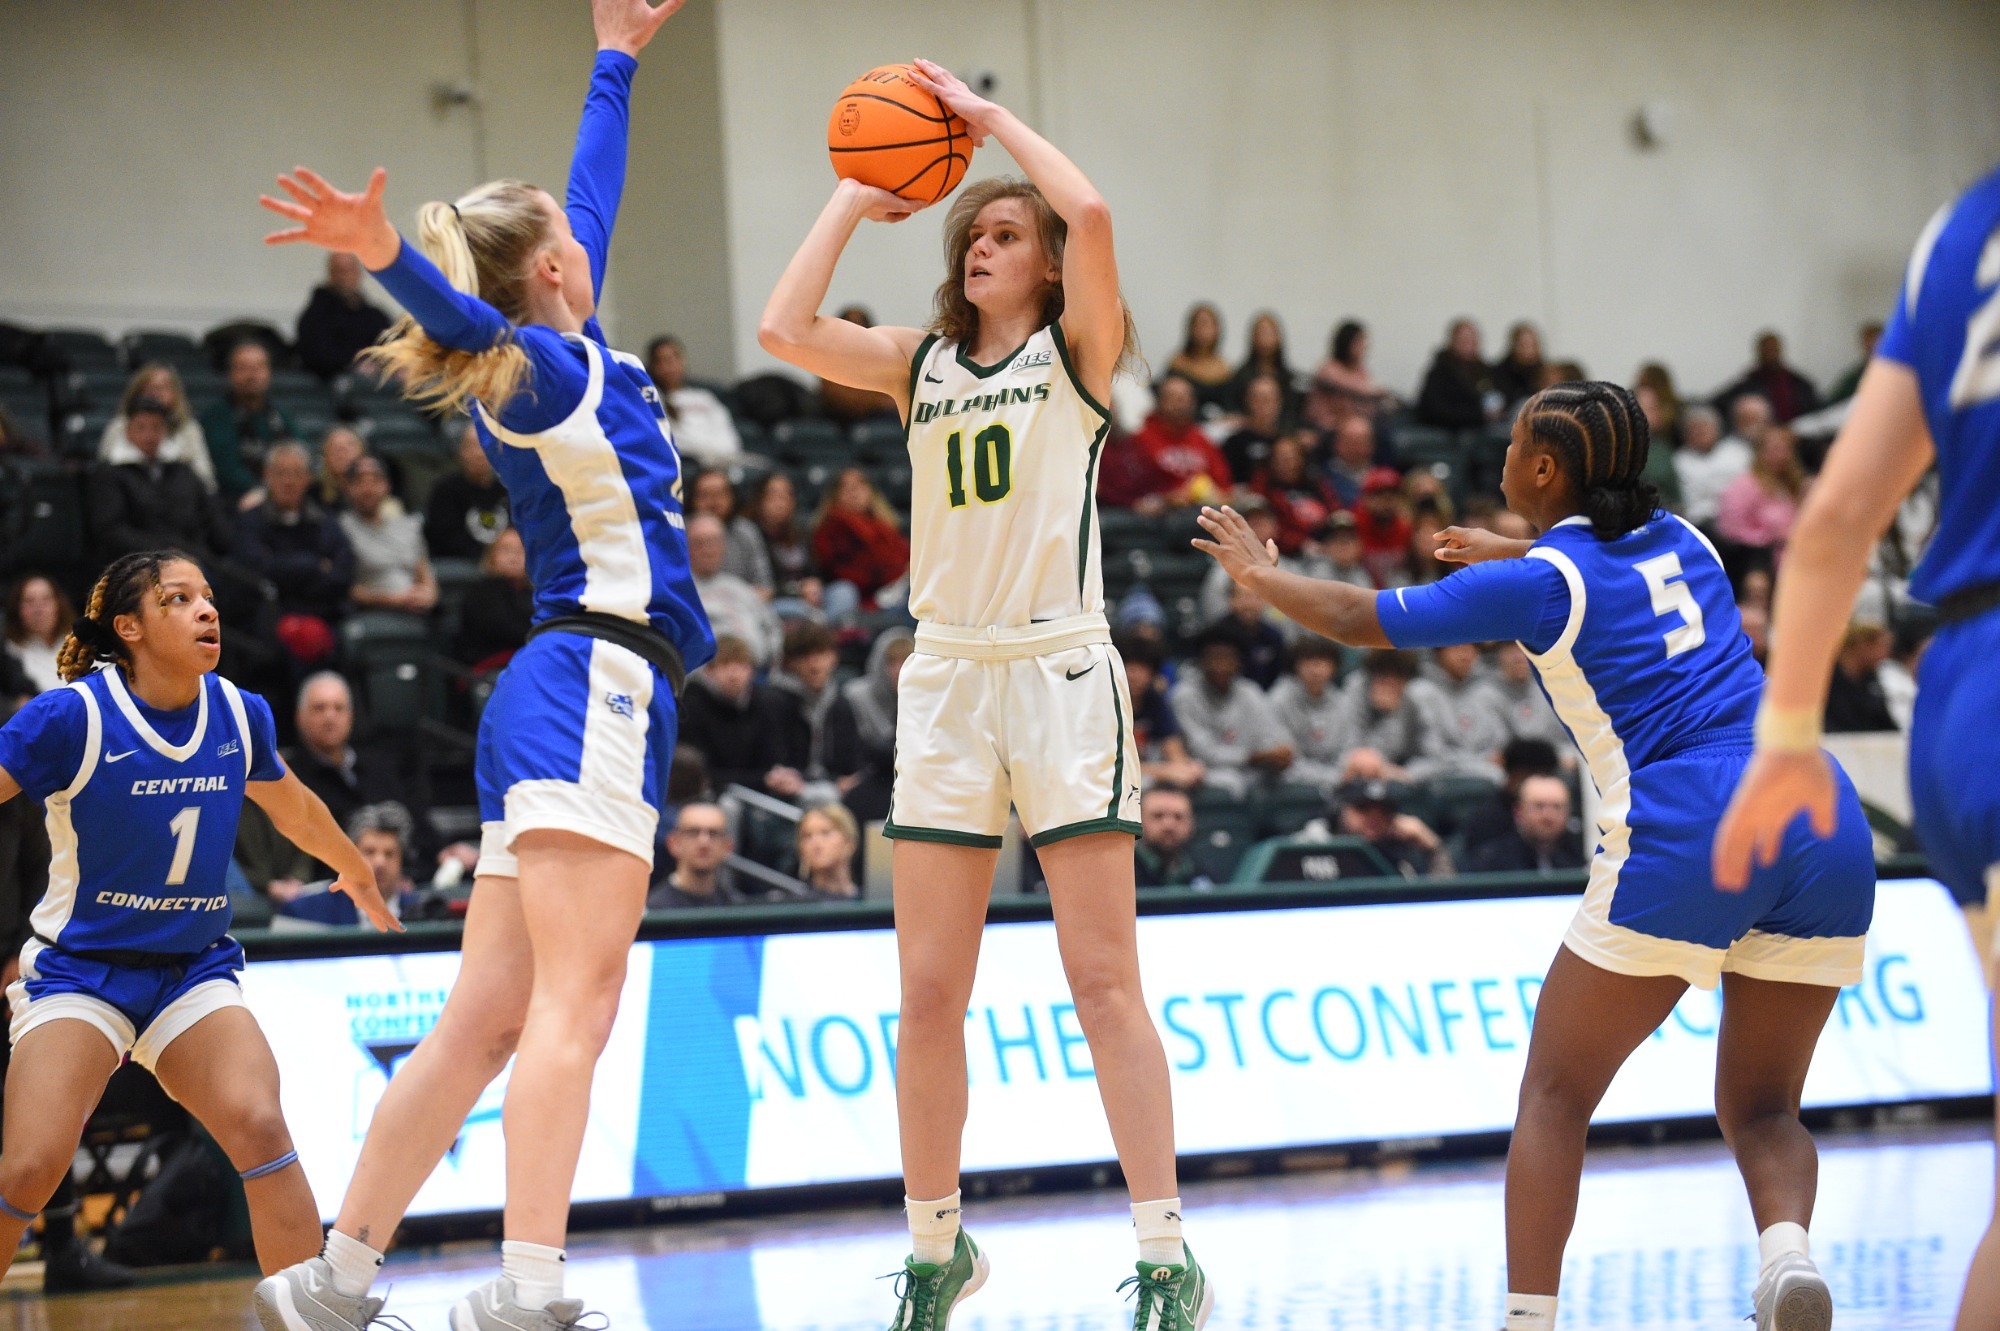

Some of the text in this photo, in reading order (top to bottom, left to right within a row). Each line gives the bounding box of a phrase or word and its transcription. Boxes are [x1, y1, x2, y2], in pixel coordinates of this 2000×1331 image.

[1011, 350, 1052, 371] NEC
[946, 421, 1017, 511] 10
[1631, 550, 1706, 660] 5
[130, 775, 229, 796] CENTRAL
[164, 805, 202, 886] 1
